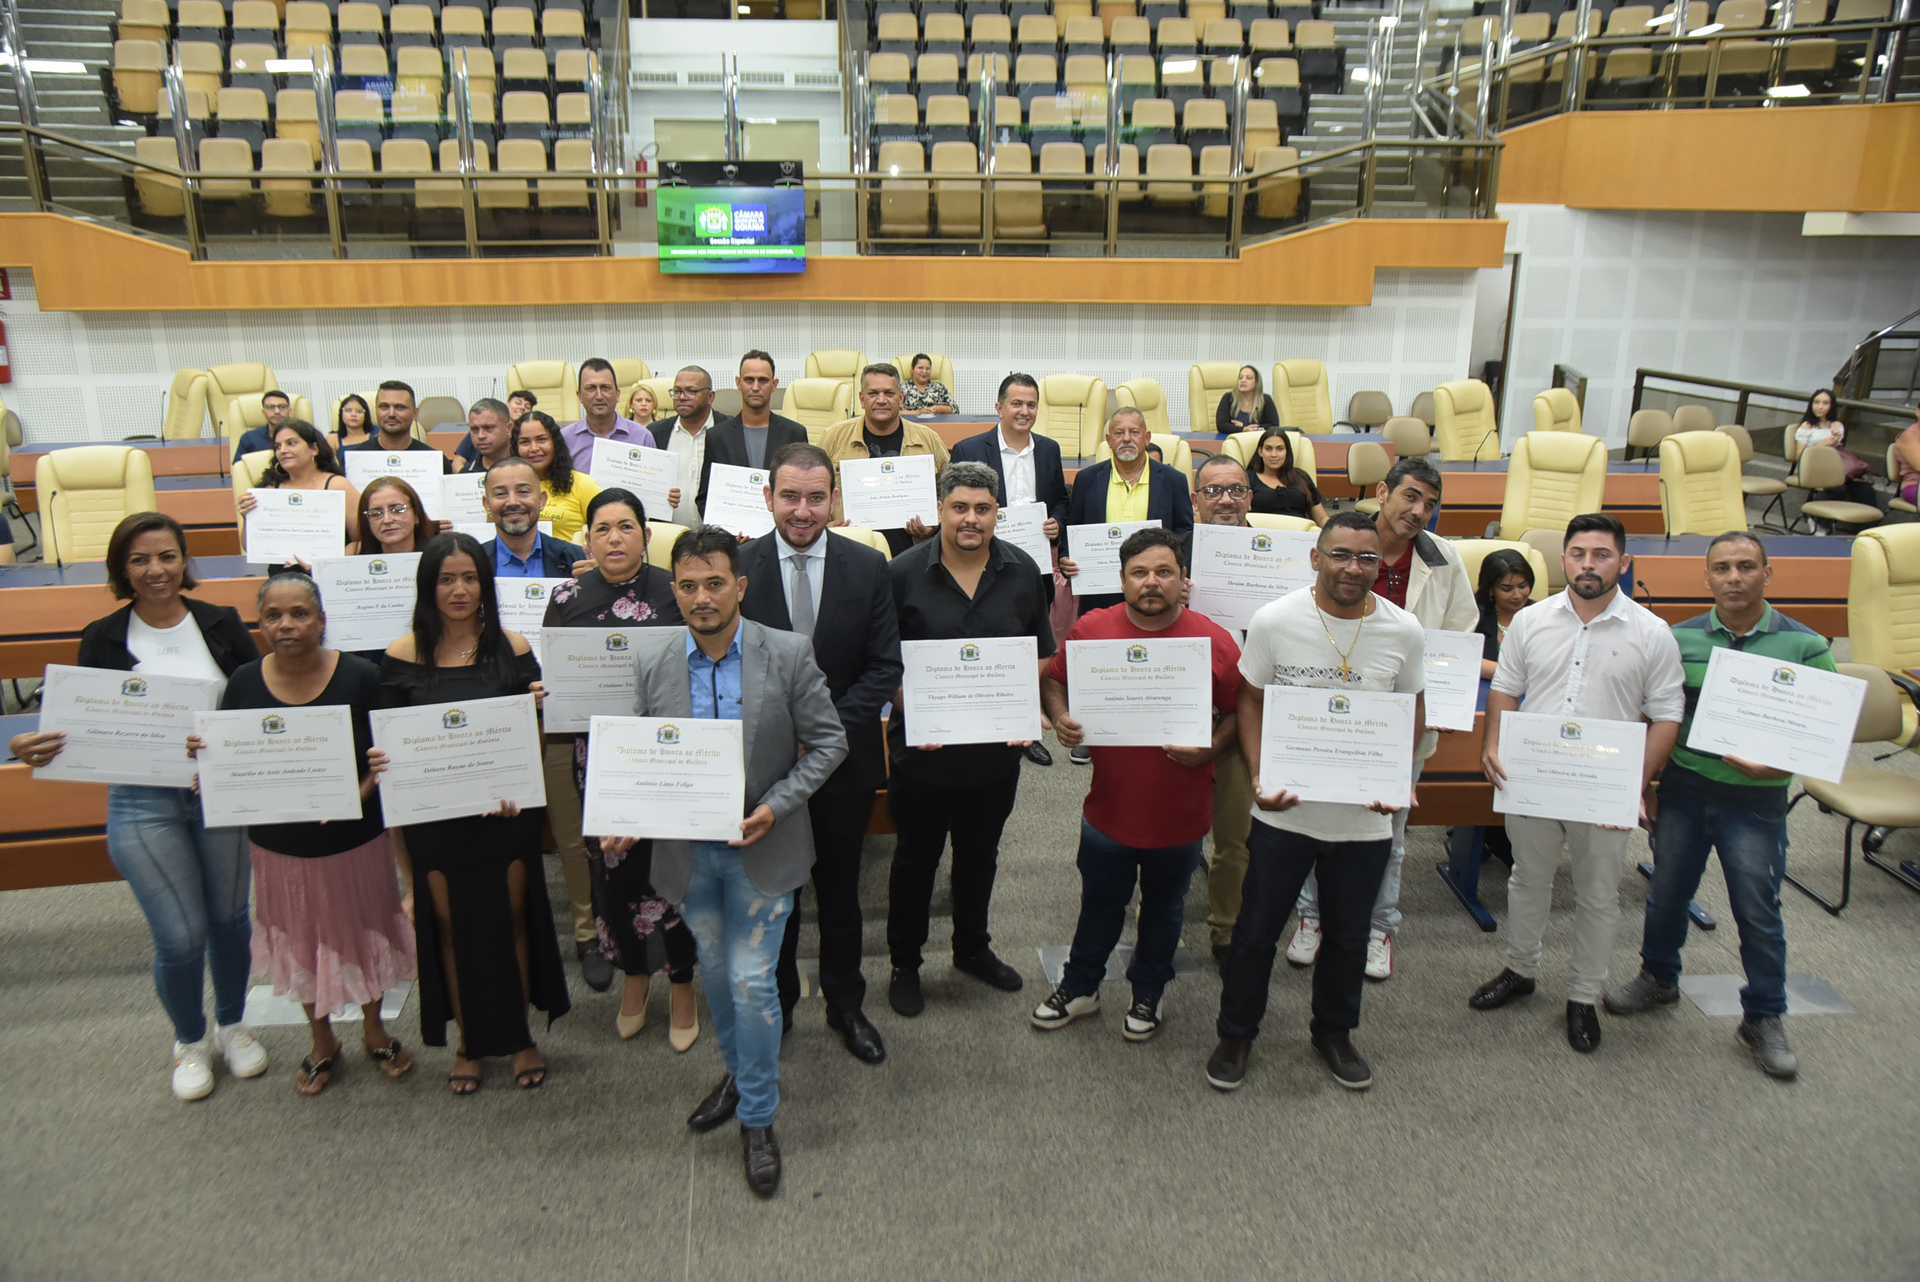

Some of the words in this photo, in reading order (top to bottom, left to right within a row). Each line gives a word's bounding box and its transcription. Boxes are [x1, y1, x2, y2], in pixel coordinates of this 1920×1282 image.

[734, 209, 764, 218] CÂMARA
[734, 222, 764, 231] GOIÂNIA
[731, 238, 755, 246] Especial
[1214, 551, 1242, 559] Diploma
[1246, 581, 1266, 589] Barbosa
[568, 654, 597, 662] Diploma
[994, 663, 1015, 671] Mérito
[1091, 666, 1118, 674] Diploma
[1163, 665, 1186, 673] Mérito
[1730, 676, 1759, 689] Diploma
[75, 695, 109, 705] Diploma
[162, 702, 189, 711] Mérito
[111, 708, 142, 716] Municipal
[1288, 713, 1317, 723] Diploma
[1364, 719, 1388, 728] Mérito
[403, 736, 435, 745] Diploma
[486, 726, 511, 736] Mérito
[224, 740, 255, 748] Diploma
[304, 735, 328, 744] Mérito
[415, 744, 437, 752] Câmara
[439, 741, 468, 750] Municipal
[477, 736, 500, 744] Goiânia
[617, 746, 647, 755] Diploma
[695, 748, 720, 757] Mérito
[1313, 746, 1333, 754] Pereira
[650, 757, 677, 765] Municipal
